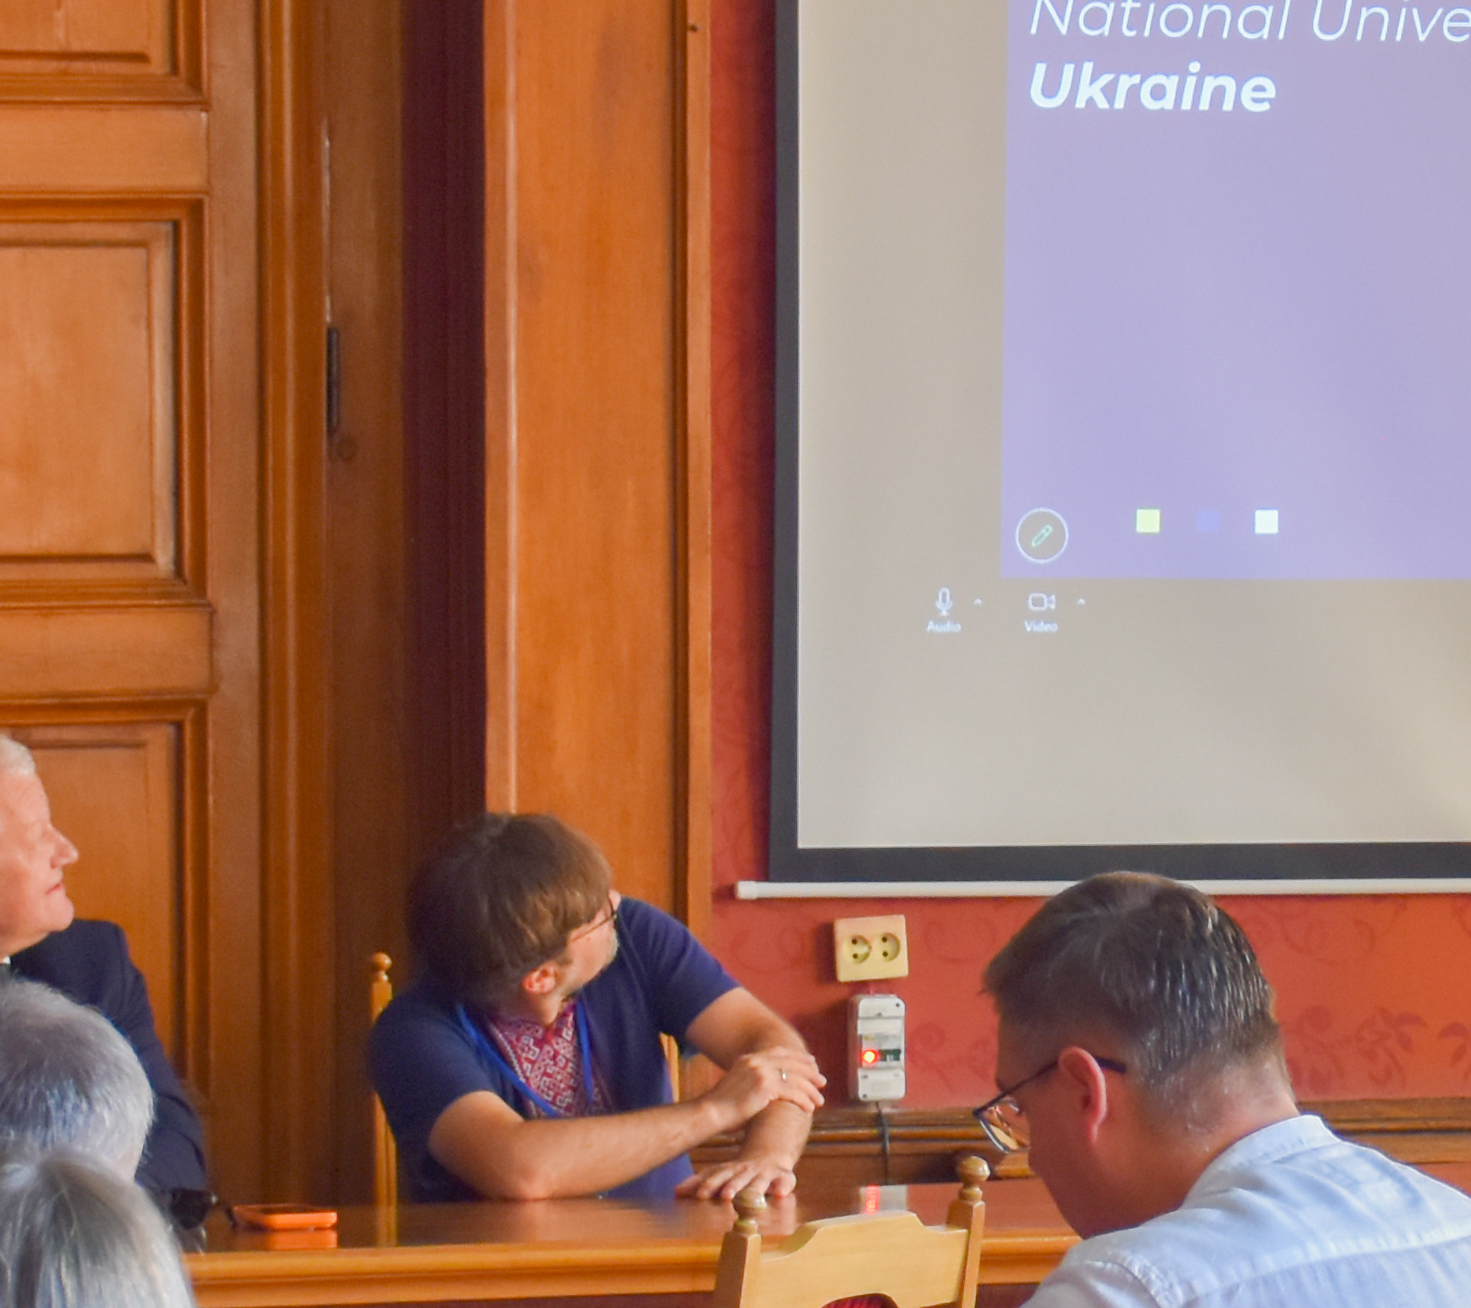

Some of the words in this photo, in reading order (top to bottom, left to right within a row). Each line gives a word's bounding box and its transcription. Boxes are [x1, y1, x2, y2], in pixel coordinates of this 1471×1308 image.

[1029, 61, 1278, 113] Ukraine
[926, 620, 962, 633] Audio
[1024, 620, 1058, 633] Video
